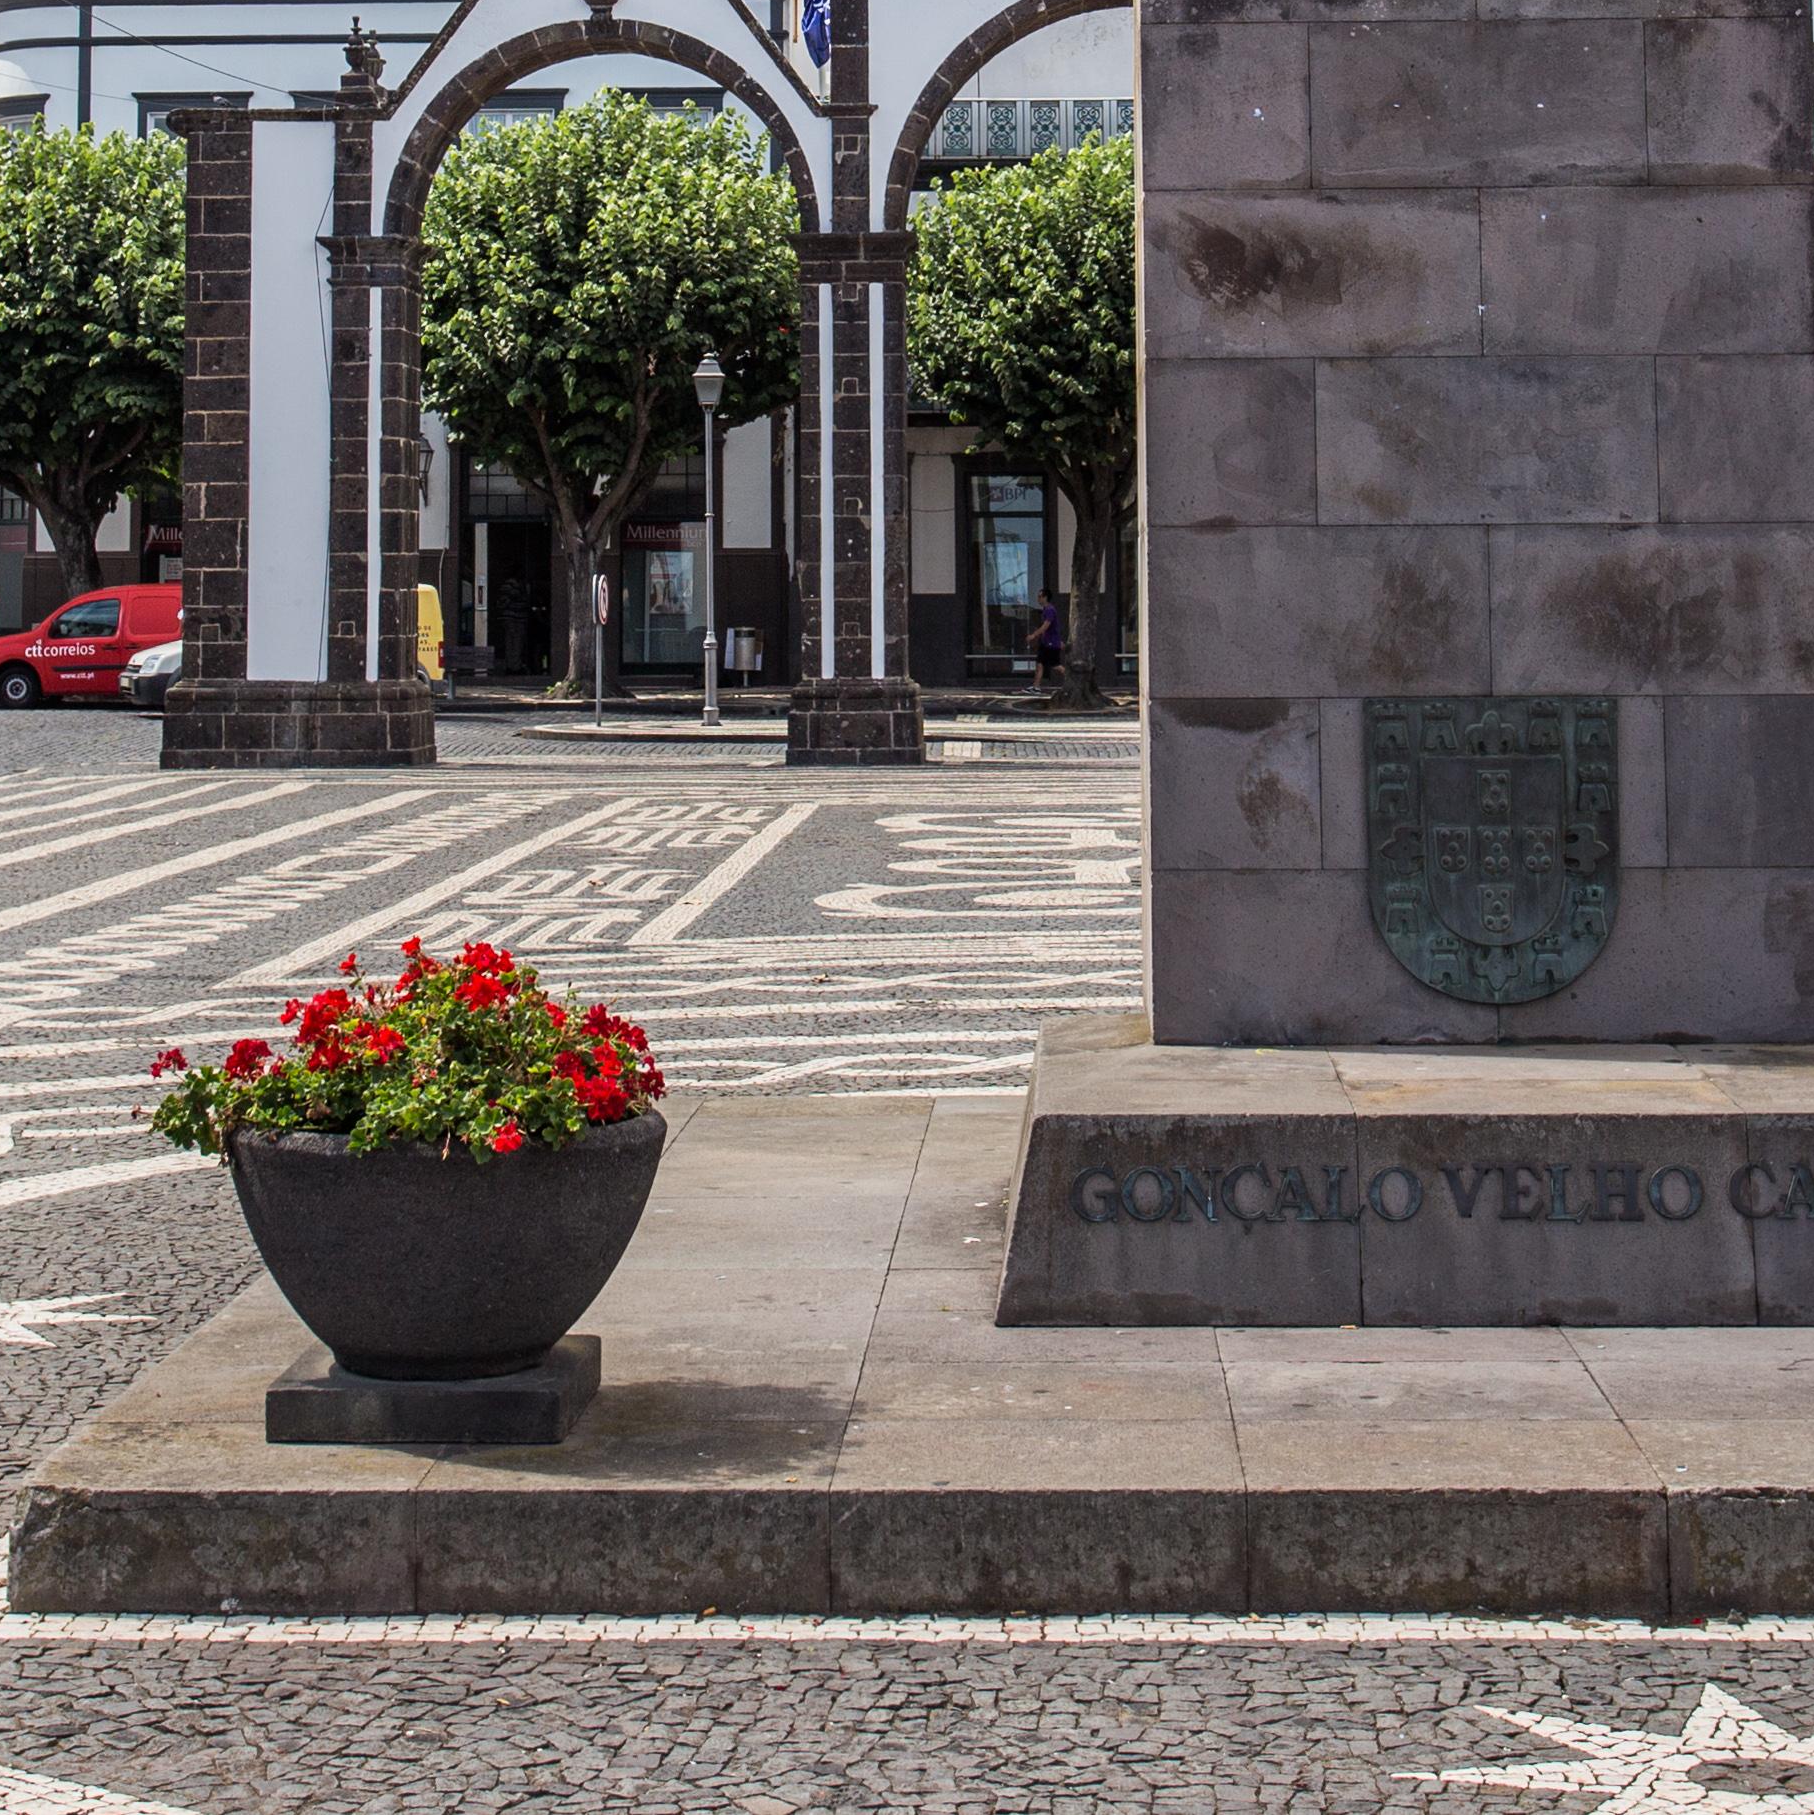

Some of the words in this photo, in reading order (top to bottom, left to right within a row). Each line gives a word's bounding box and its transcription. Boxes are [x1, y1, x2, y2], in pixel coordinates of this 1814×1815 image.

[25, 644, 43, 657] ctt
[44, 642, 96, 657] correios
[1440, 1160, 1704, 1224] VELHO
